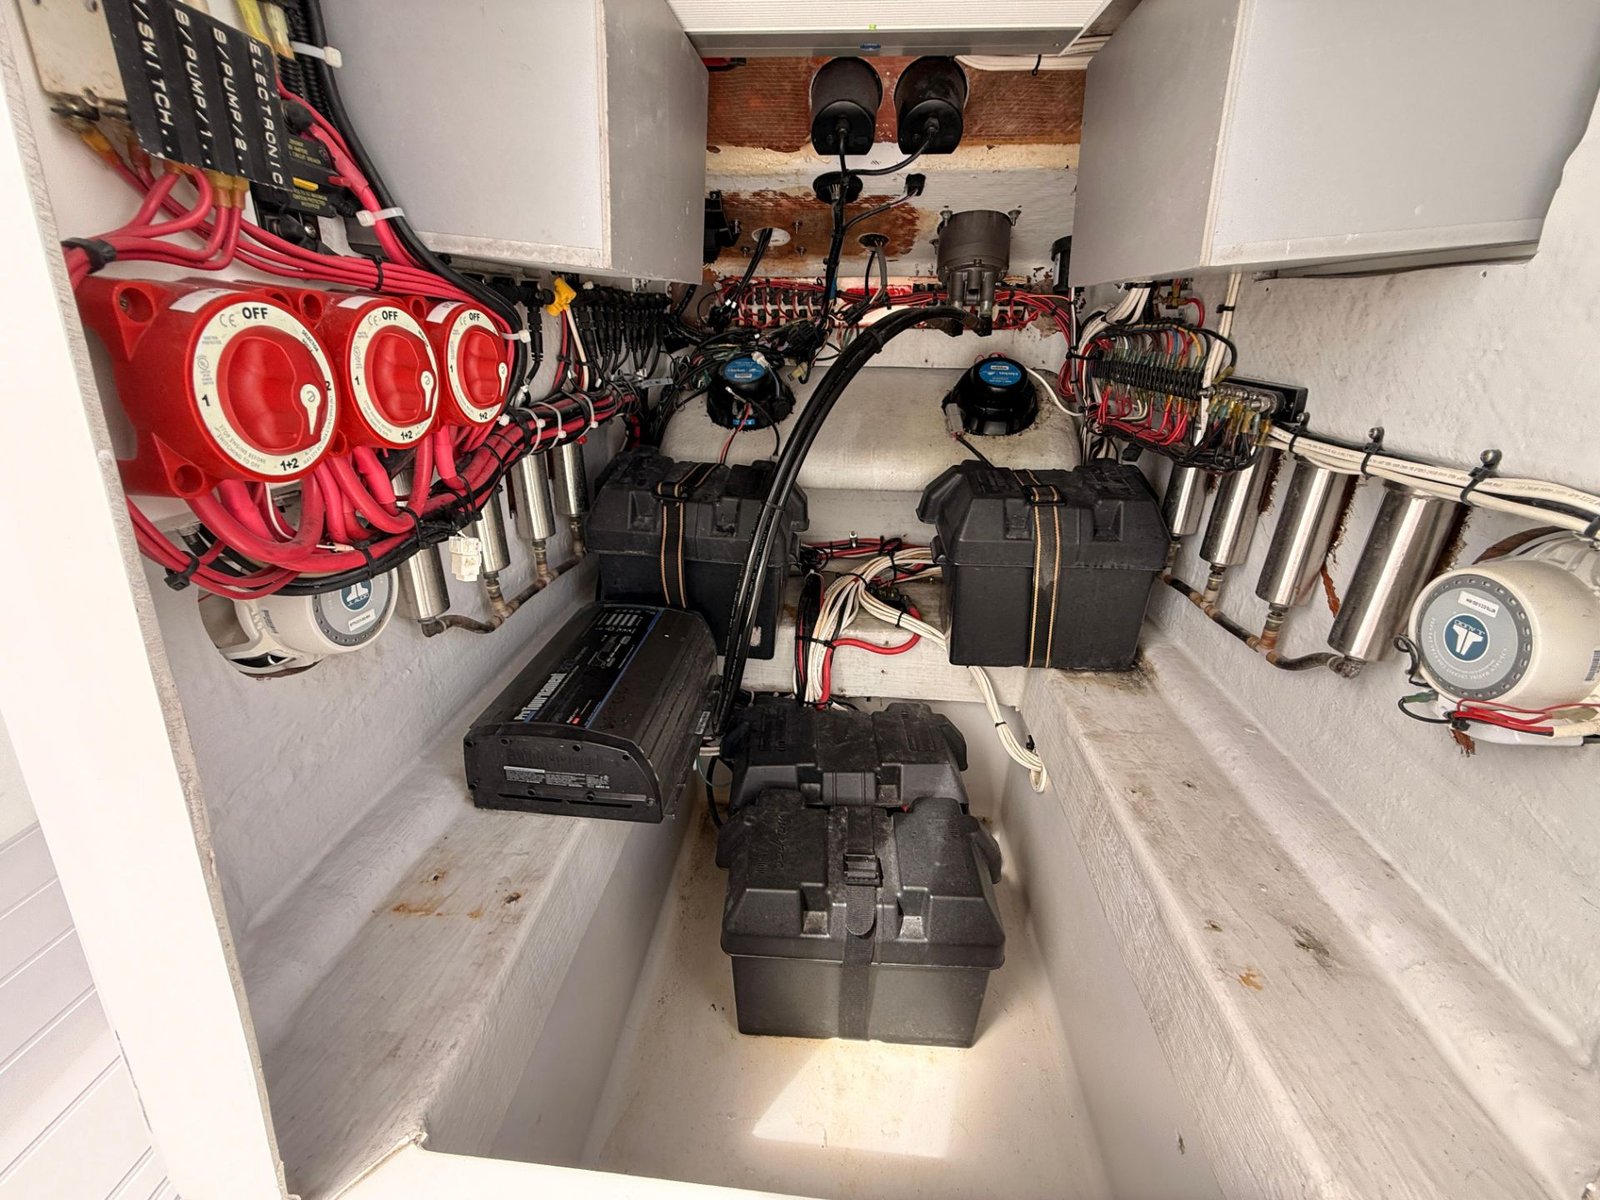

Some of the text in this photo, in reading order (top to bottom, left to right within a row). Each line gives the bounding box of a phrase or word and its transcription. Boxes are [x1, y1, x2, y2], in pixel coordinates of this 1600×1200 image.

[248, 41, 284, 185] ELECTRONIC
[242, 306, 269, 320] OFF
[382, 310, 398, 321] OFF
[469, 312, 480, 322] OFF
[449, 364, 454, 373] 1
[324, 380, 332, 391] 2
[354, 375, 360, 386] 1
[201, 394, 211, 407] 1
[478, 411, 488, 420] 1+2
[400, 430, 414, 440] 1+2
[279, 457, 300, 472] 1+2
